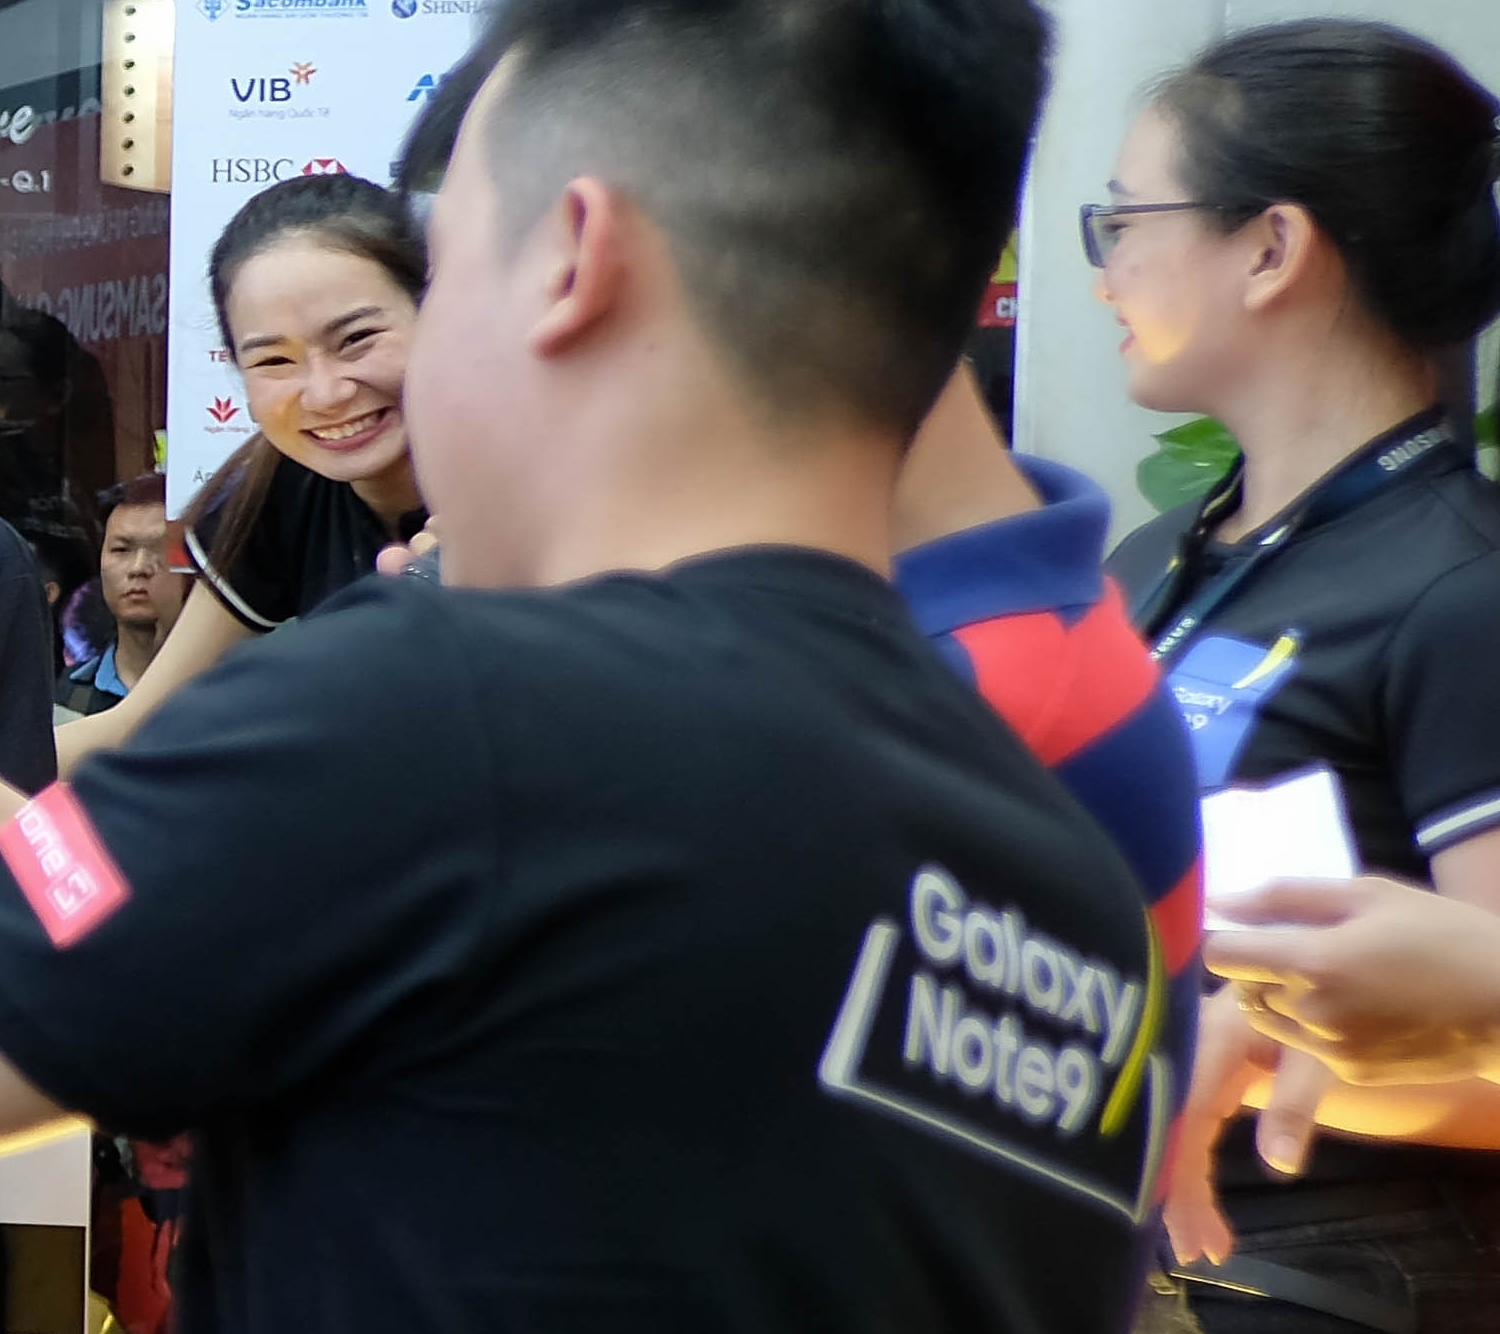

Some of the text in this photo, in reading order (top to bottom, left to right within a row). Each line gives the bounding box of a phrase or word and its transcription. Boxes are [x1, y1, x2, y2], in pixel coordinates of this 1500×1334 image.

[422, 0, 488, 15] SHINH
[231, 77, 291, 102] VIB
[212, 158, 294, 183] HSBC
[909, 864, 1138, 1064] Galaxy
[903, 973, 1100, 1137] Note9
